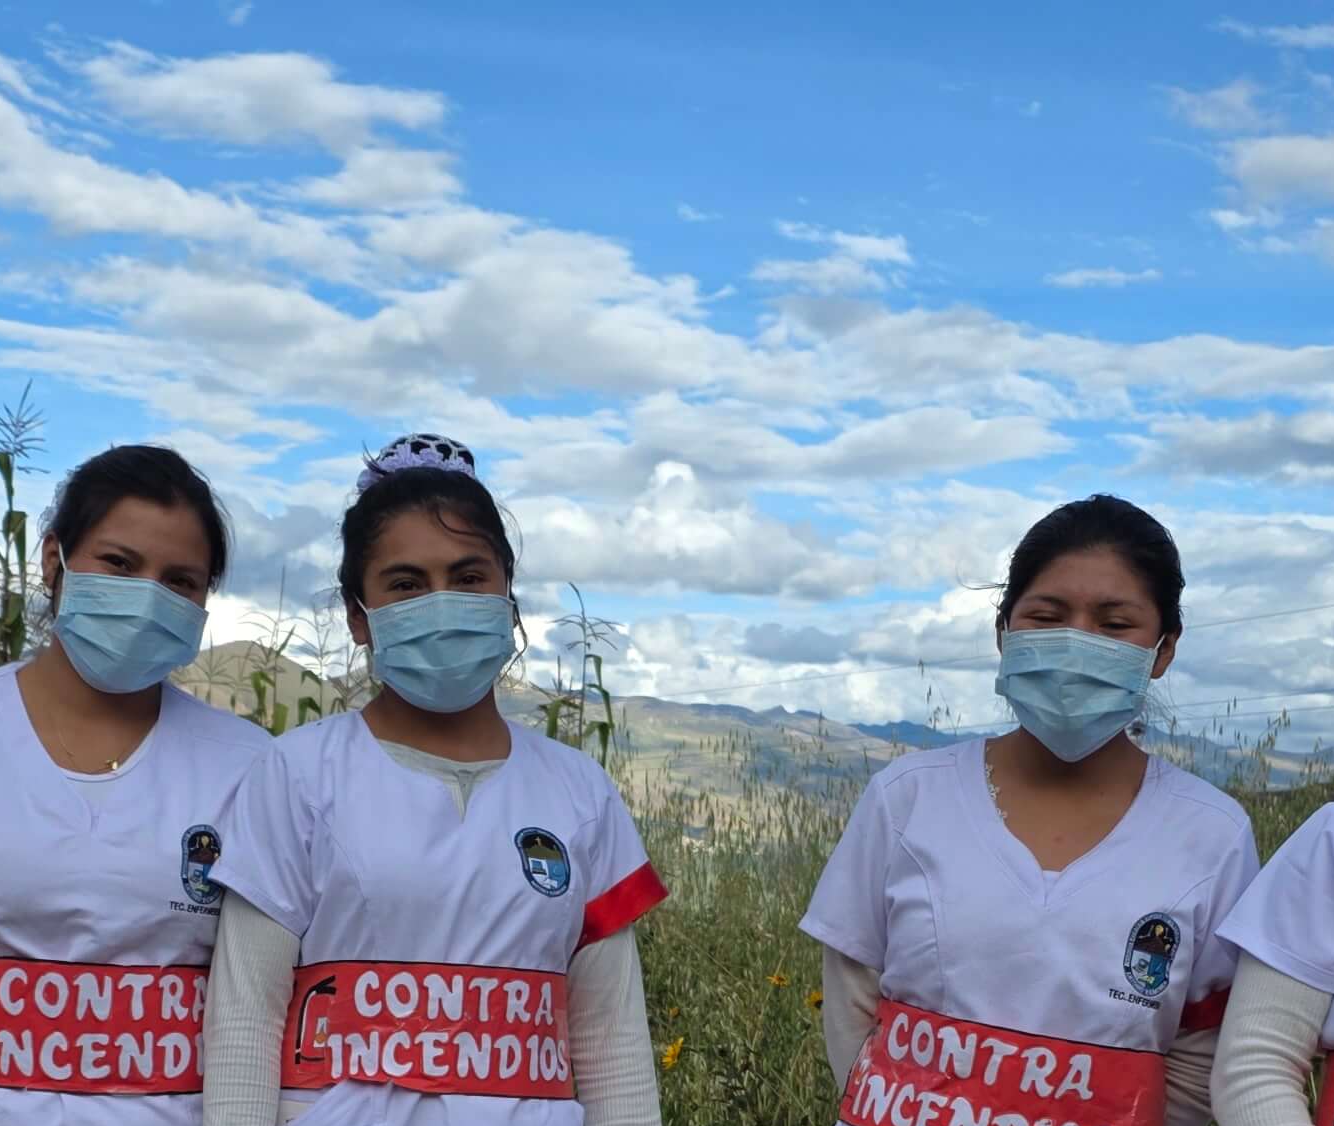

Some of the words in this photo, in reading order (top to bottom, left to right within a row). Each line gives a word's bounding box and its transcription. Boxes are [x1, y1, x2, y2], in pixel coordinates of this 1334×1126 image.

[354, 970, 555, 1027] CONTRA
[326, 1030, 568, 1082] INCENDIOS
[887, 1012, 1094, 1101] CONTRA
